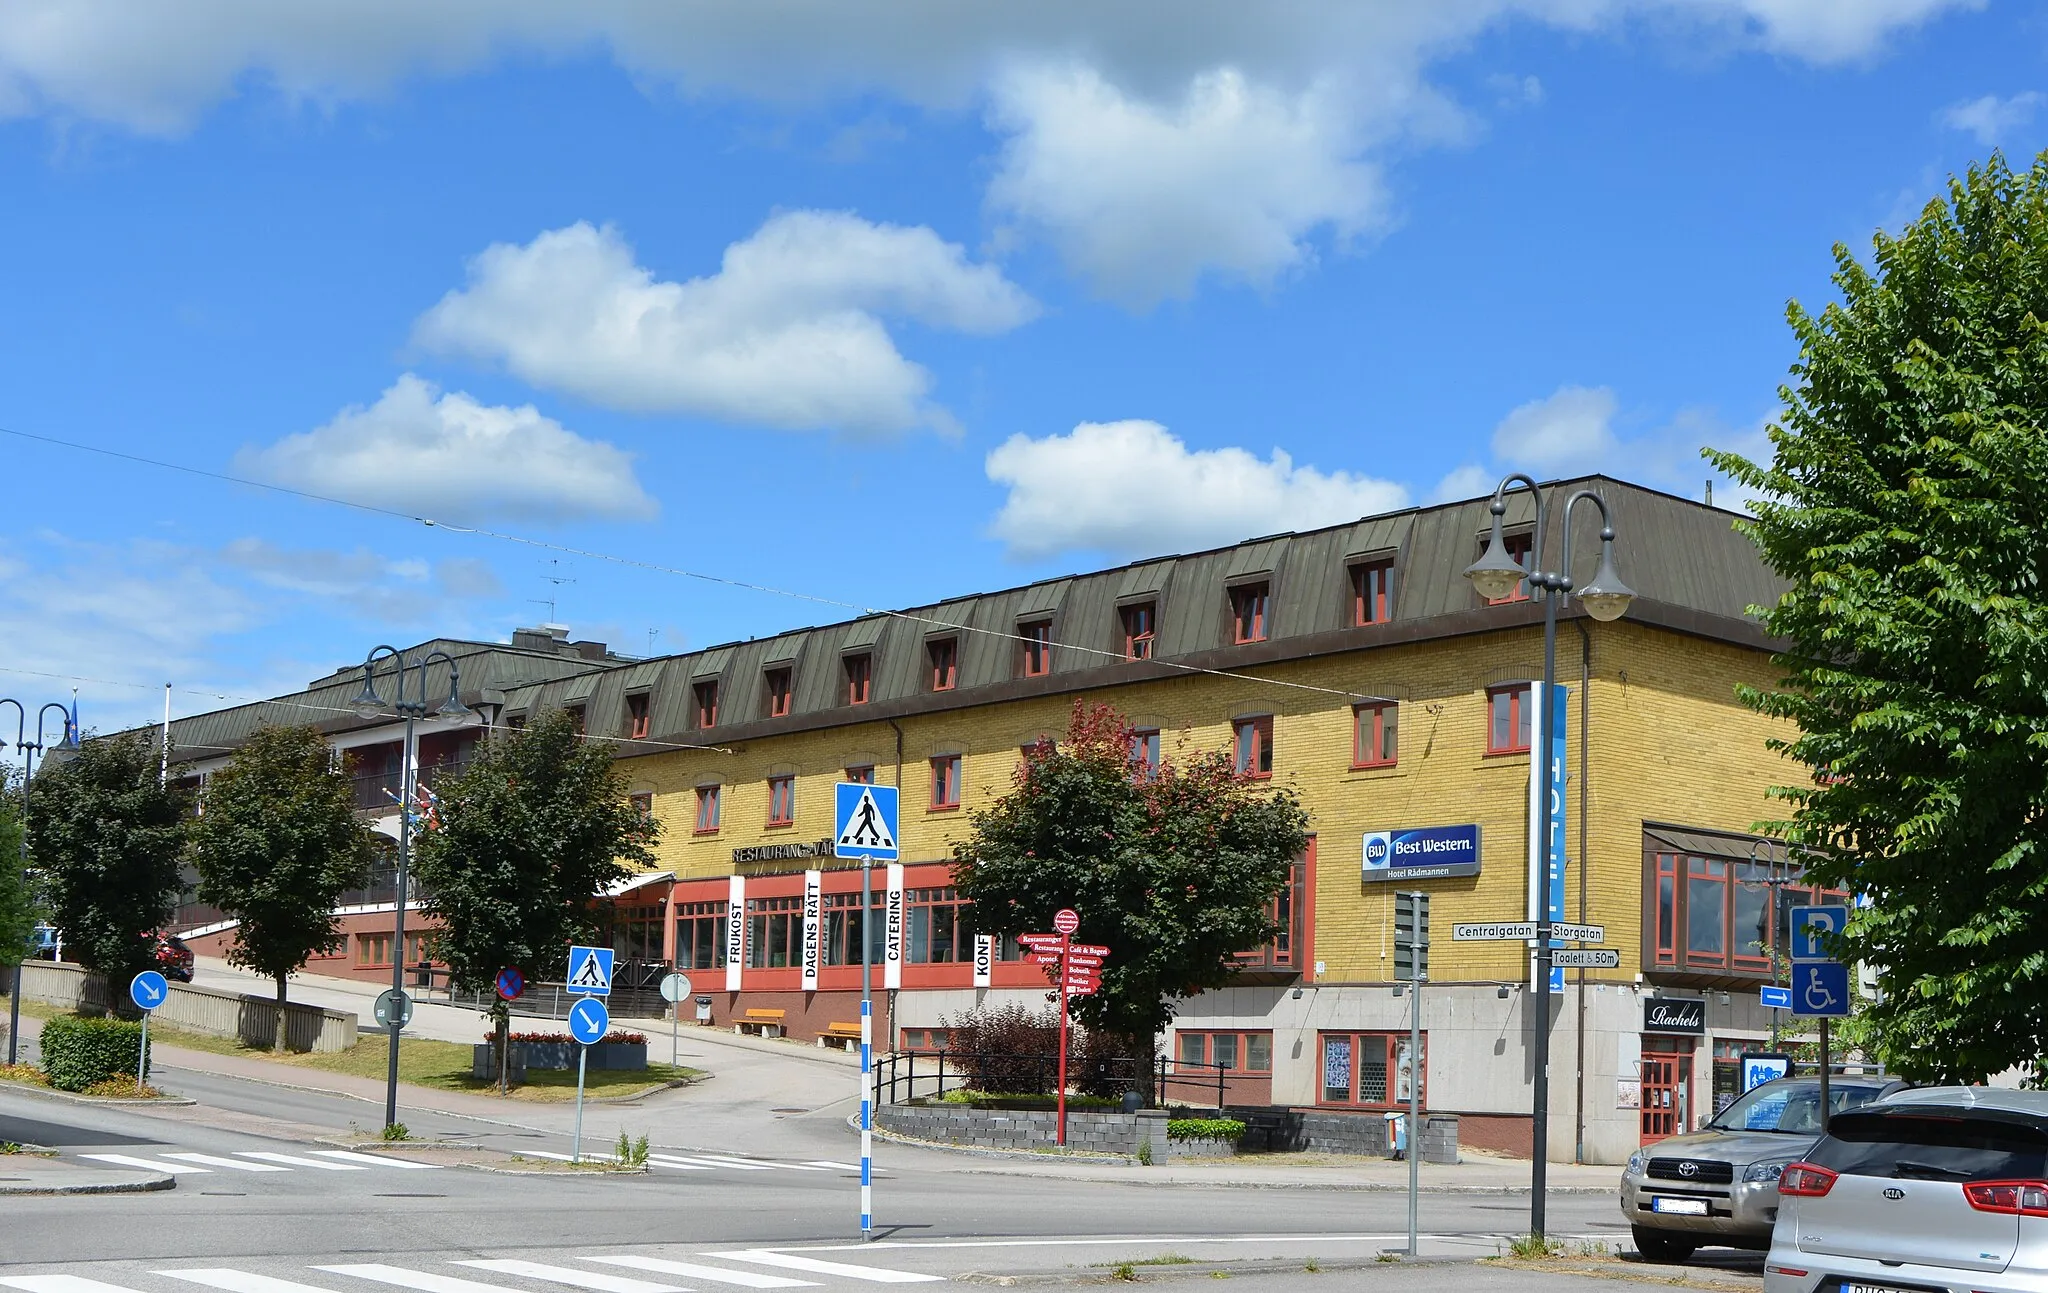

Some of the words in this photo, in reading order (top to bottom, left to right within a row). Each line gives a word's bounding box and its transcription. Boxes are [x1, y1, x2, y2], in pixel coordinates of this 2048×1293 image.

[732, 843, 805, 862] RESTAURANG
[1368, 845, 1385, 858] BW
[1395, 841, 1420, 855] Best
[1387, 869, 1406, 878] Hotel
[1407, 868, 1449, 877] Rådmannen
[805, 882, 818, 918] RÄTT
[730, 903, 742, 963] FRUKOST
[888, 891, 901, 961] CATERING
[1458, 925, 1532, 938] Centralgatan
[1554, 925, 1601, 940] Storgatan
[1808, 913, 1834, 954] P
[805, 922, 818, 977] DAGENS
[977, 935, 989, 976] KONF
[1554, 952, 1584, 963] Toalett
[1595, 953, 1615, 963] 50m
[1648, 1002, 1700, 1027] Rachels
[1886, 1189, 1902, 1199] KIA
